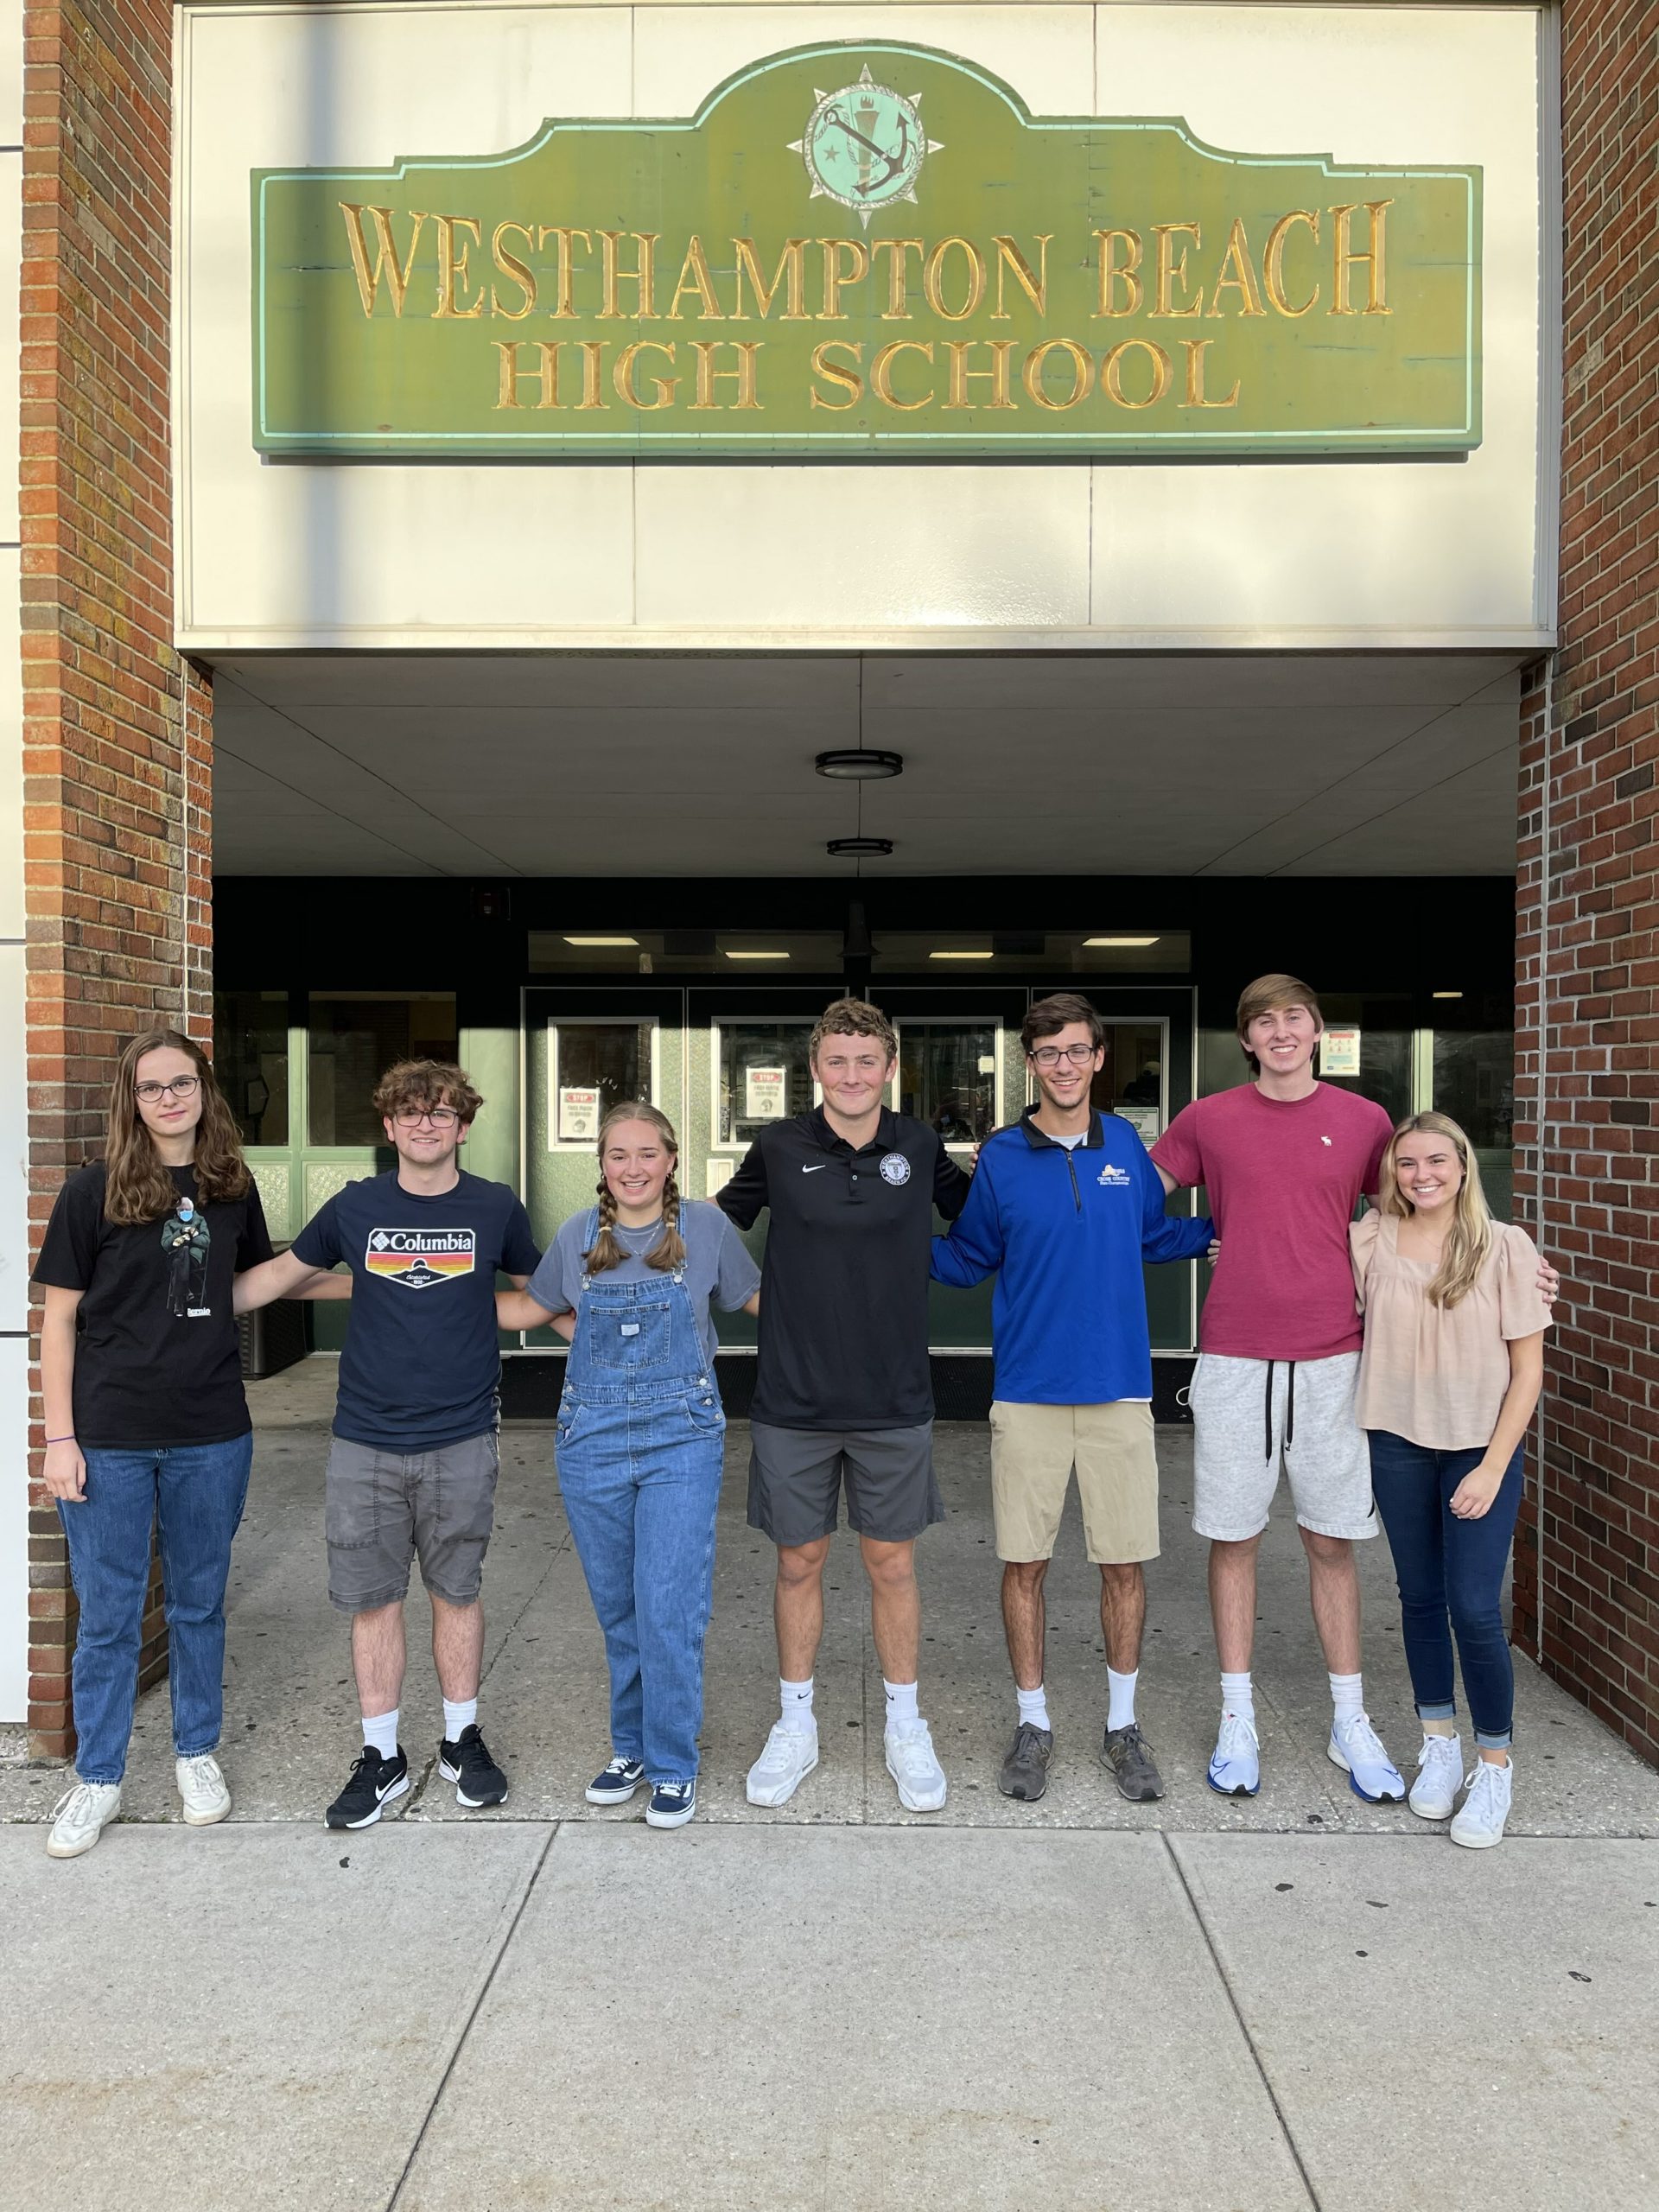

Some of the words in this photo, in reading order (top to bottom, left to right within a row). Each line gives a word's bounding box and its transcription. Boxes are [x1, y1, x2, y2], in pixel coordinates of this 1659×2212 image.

[338, 200, 1053, 321] WESTHAMPTON
[1090, 198, 1395, 319] BEACH
[490, 340, 766, 410] HIGH
[810, 338, 1241, 411] SCHOOL
[391, 1233, 472, 1251] Columbia
